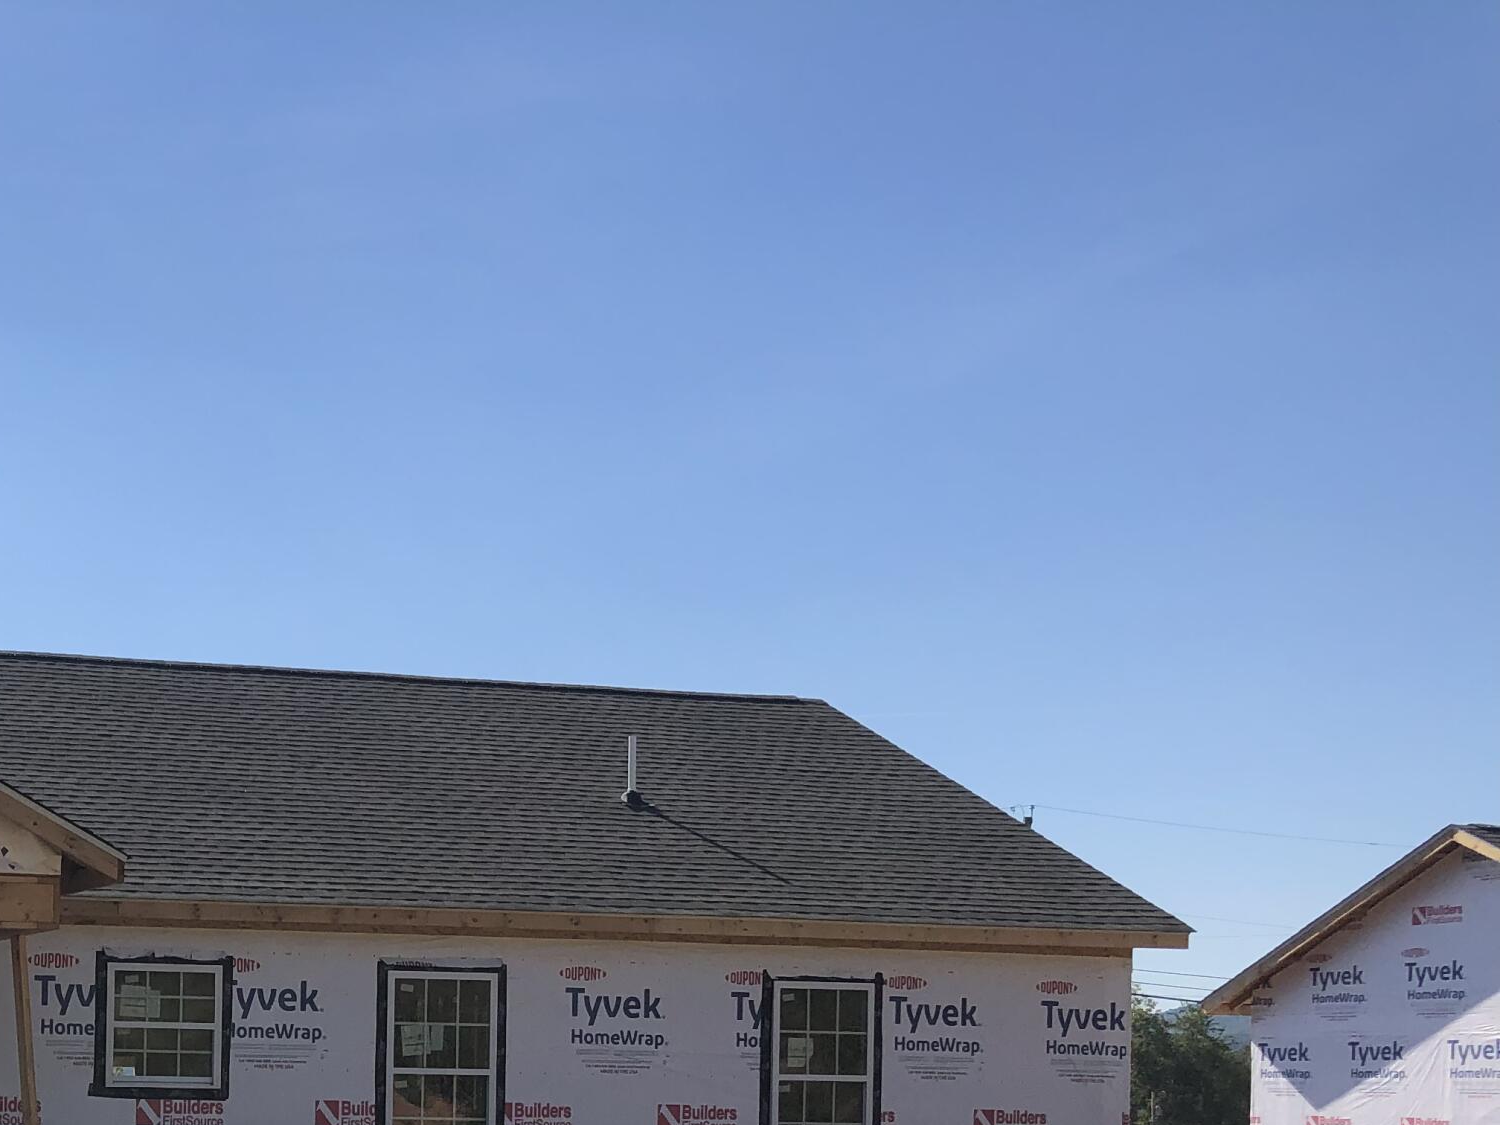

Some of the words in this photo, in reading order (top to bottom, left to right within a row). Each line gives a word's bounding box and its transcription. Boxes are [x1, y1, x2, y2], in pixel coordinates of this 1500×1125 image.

[34, 953, 74, 968] DUPONT
[232, 959, 256, 973] PONT
[565, 966, 602, 981] DUPONT
[1310, 965, 1362, 990] Tyvek
[1405, 960, 1463, 987] Tyvek
[889, 976, 923, 990] DUPONT
[1041, 981, 1074, 994] DUPONT
[34, 975, 97, 1015] Tyv
[1312, 992, 1364, 1003] HomeWrap
[1407, 988, 1464, 1001] HomeWrap
[566, 987, 662, 1025] Tyvek
[889, 996, 978, 1033] Tyvek
[1041, 1000, 1125, 1037] Tyvek
[41, 1019, 95, 1036] Home
[571, 1029, 664, 1049] HomeWrap
[894, 1036, 980, 1055] HomeWrap
[1046, 1040, 1127, 1059] HomeWrap
[1259, 1042, 1308, 1066] Tyvek
[1348, 1041, 1403, 1066] Tyvek
[1260, 1069, 1311, 1079] HomeWrap
[1351, 1068, 1406, 1079] HomeWrap
[163, 1100, 223, 1114] Builders
[514, 1103, 572, 1118] Builders
[683, 1105, 737, 1120] Builders
[996, 1110, 1046, 1124] Builders
